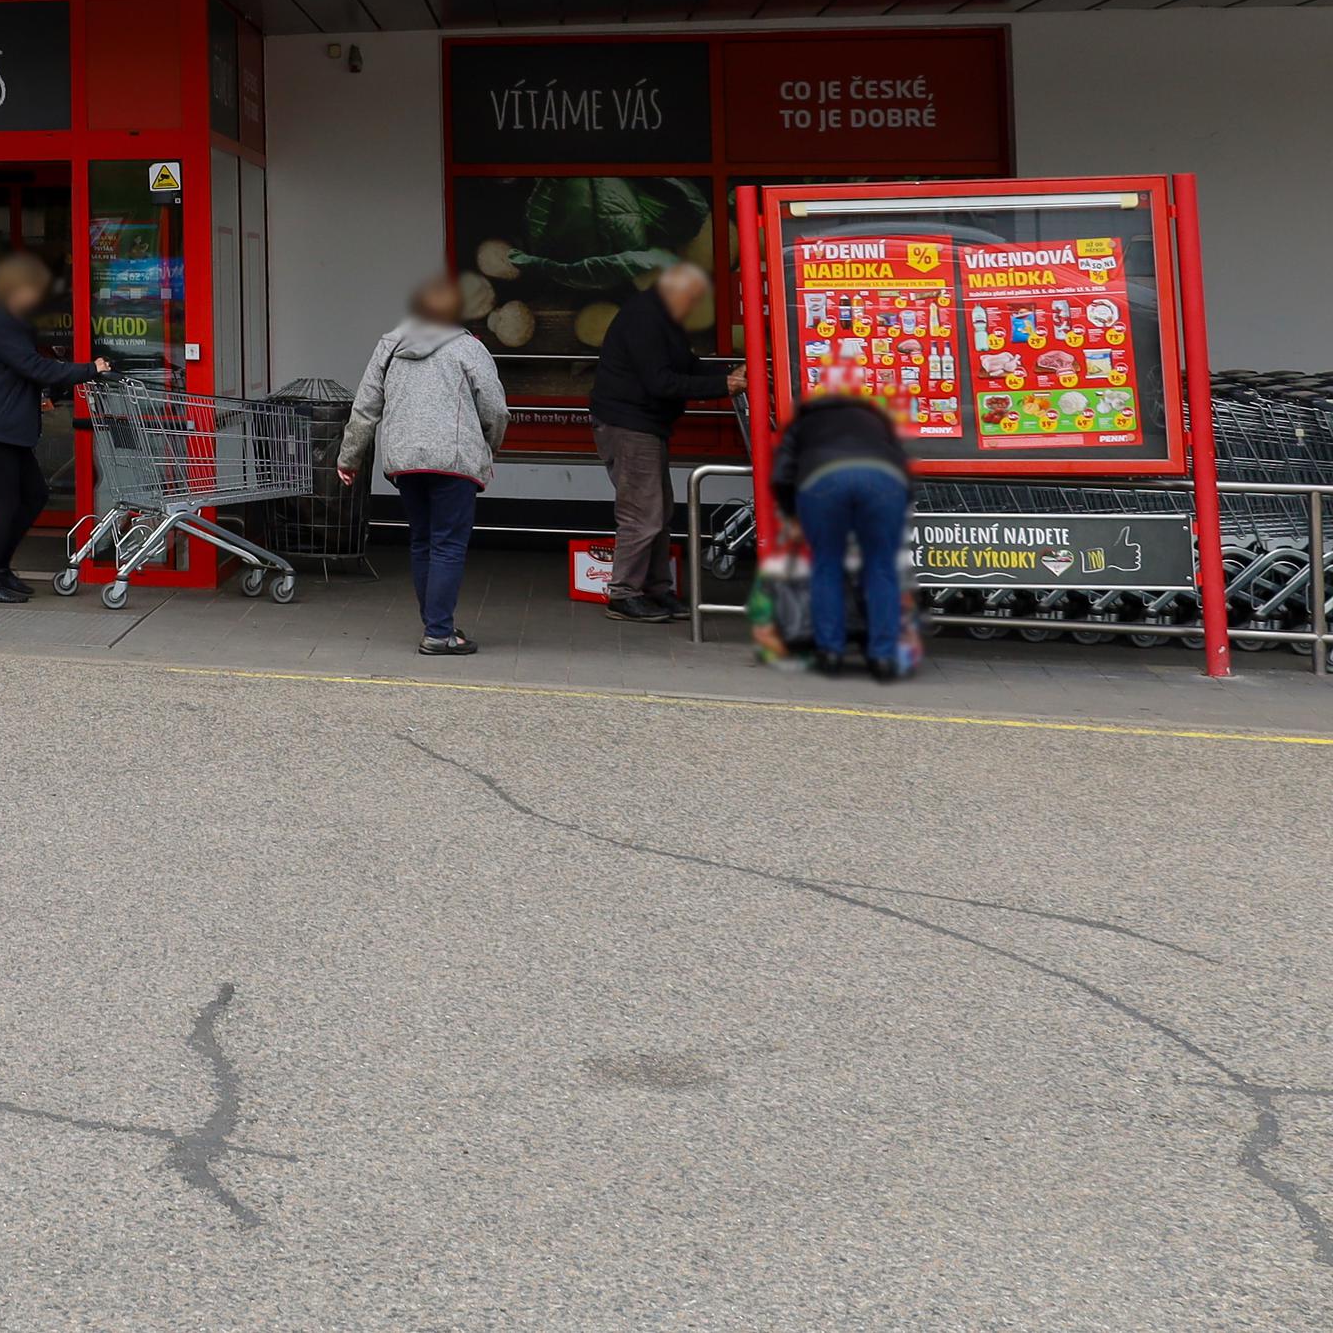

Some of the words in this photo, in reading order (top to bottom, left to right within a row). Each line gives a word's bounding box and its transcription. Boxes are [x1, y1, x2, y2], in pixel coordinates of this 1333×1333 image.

[780, 81, 811, 100] CO
[818, 80, 841, 104] JE
[849, 75, 934, 100] ČESKÉ,
[490, 78, 604, 131] VÍTÁME
[612, 78, 663, 130] VÁS
[779, 109, 811, 128] TO
[818, 108, 842, 132] JE
[850, 104, 937, 128] DOBRÉ
[802, 239, 886, 260] TÝDENNÍ
[964, 245, 1076, 269] VÍKENDOVÁ
[804, 259, 894, 279] NABÍDKA
[968, 268, 1057, 288] NABÍDKA
[91, 316, 148, 336] VCHOD
[924, 523, 999, 544] ODDĚLENÍ
[1004, 528, 1069, 546] NAJDETE
[928, 546, 968, 567] ČESKÉ
[972, 546, 1036, 568] VÝROBKY
